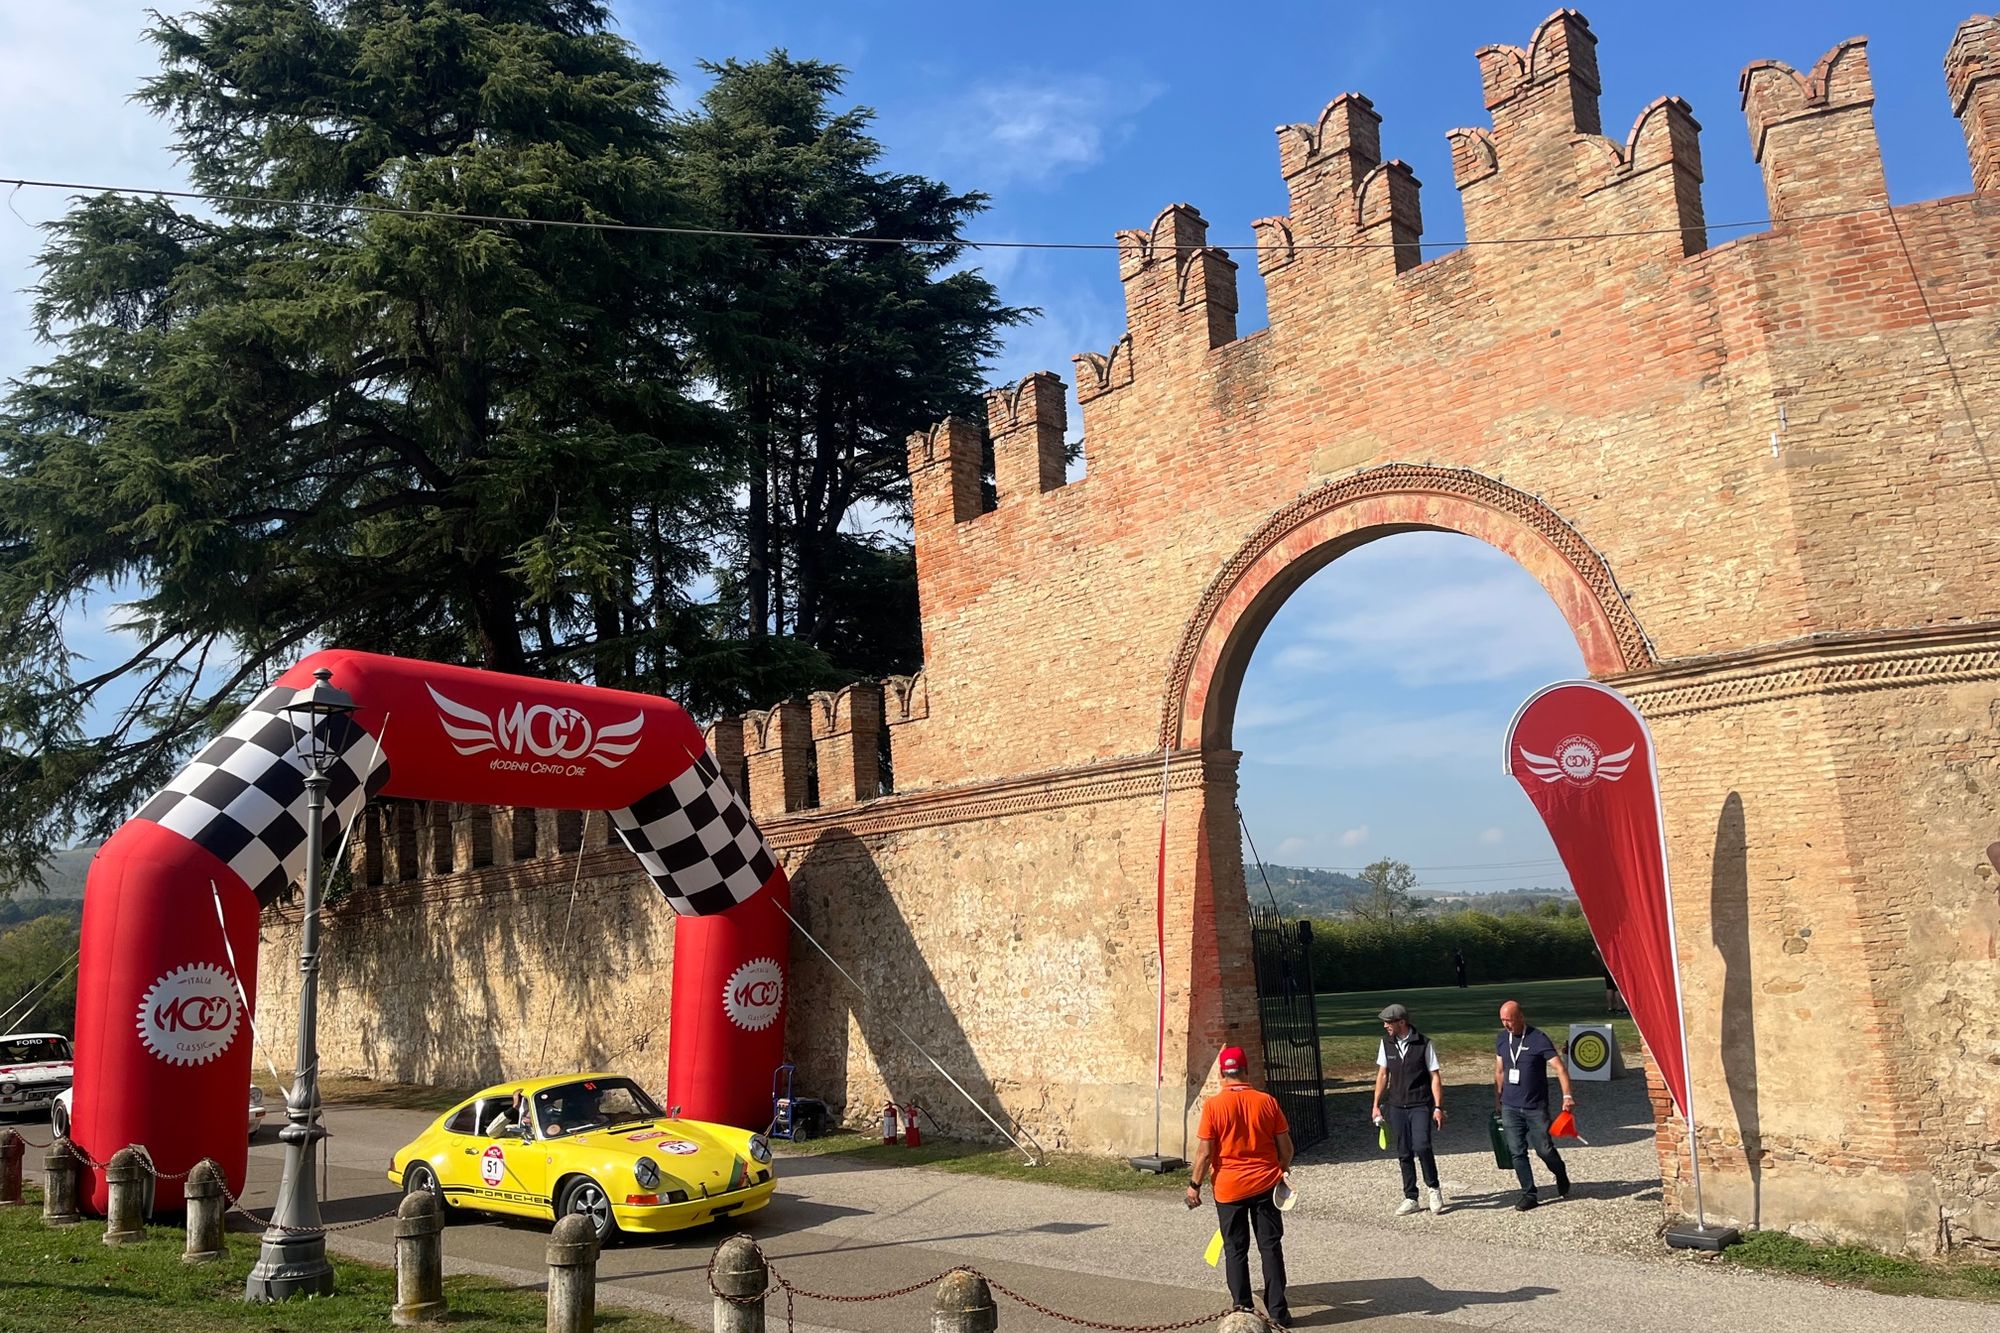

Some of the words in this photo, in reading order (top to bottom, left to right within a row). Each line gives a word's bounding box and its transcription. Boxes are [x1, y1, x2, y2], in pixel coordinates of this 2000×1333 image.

[490, 759, 529, 771] MODENA
[531, 762, 564, 774] CENTO
[566, 765, 586, 776] ORE
[176, 1041, 209, 1052] CLASSIC
[584, 1082, 597, 1090] 51
[486, 1160, 498, 1174] 51
[476, 1189, 542, 1203] PORSCHE
